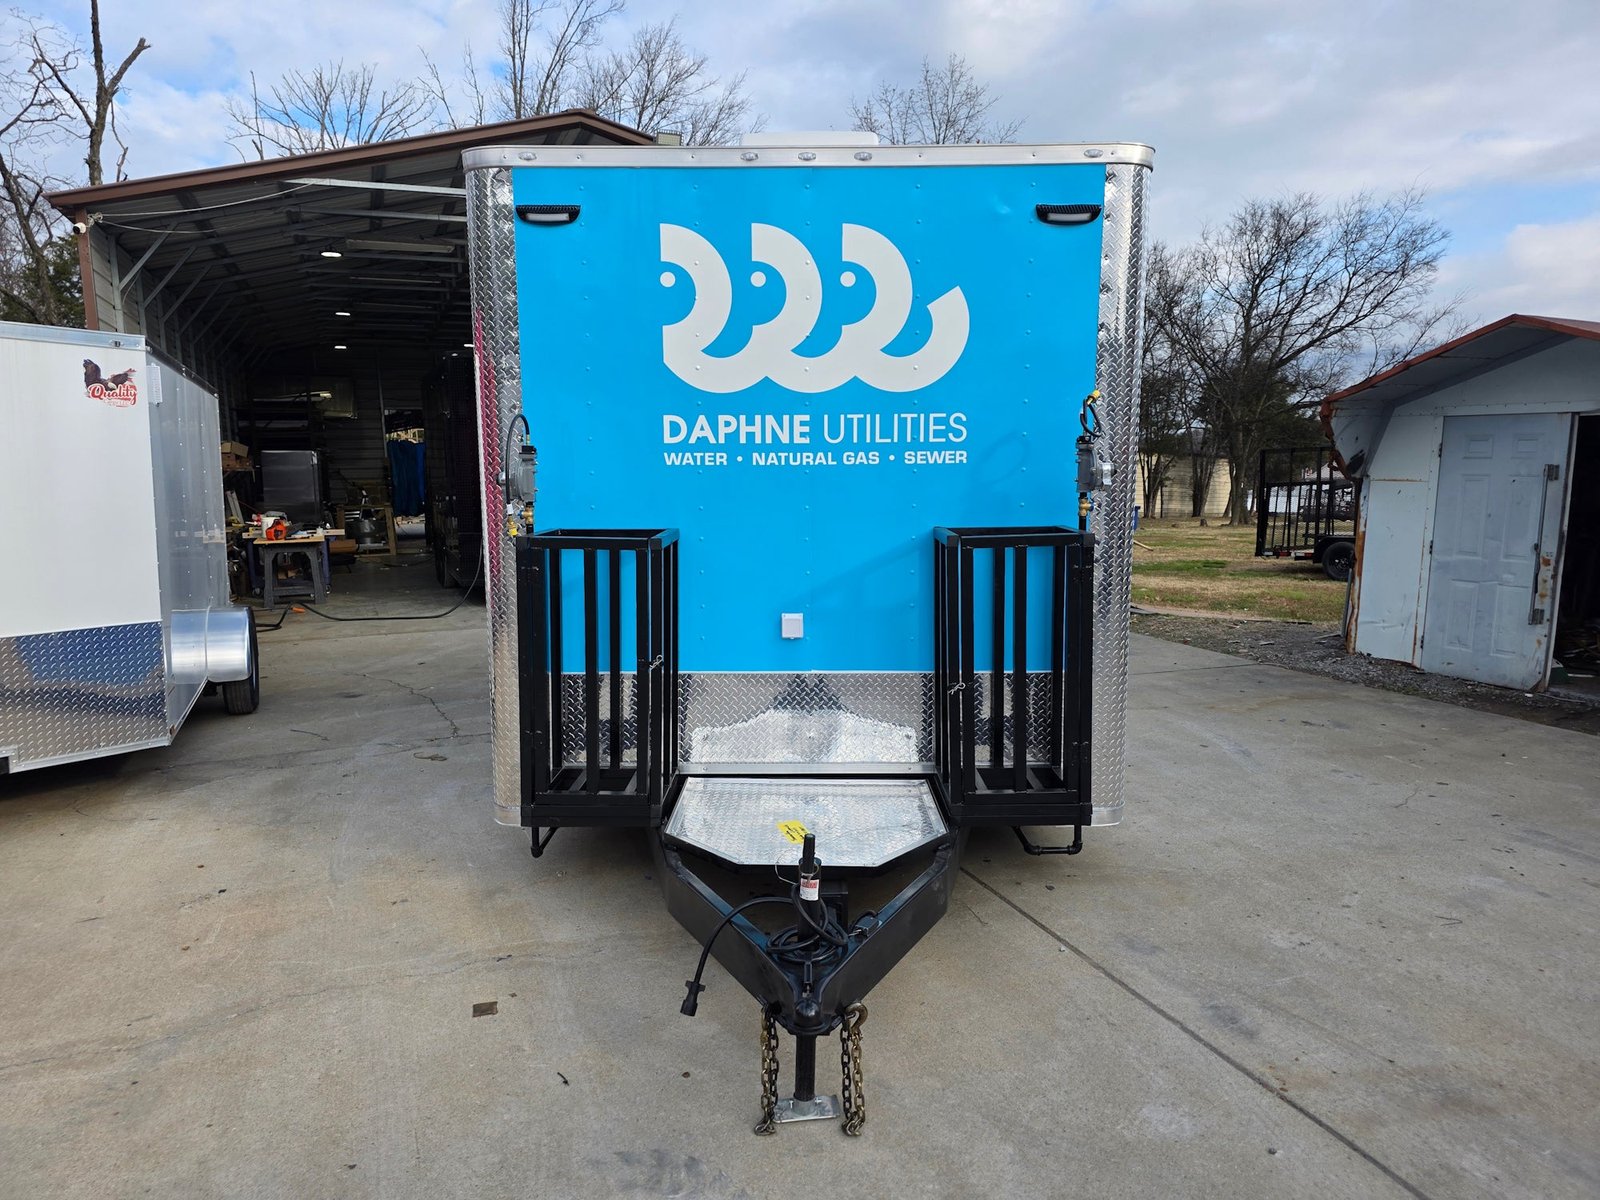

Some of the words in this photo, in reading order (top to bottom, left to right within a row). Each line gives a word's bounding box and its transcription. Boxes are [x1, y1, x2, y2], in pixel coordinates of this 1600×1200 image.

[88, 384, 137, 406] Quality
[662, 414, 811, 444] DAPHNE
[823, 412, 968, 444] UTILITIES
[663, 452, 728, 466] WATER
[752, 451, 837, 466] NATURAL
[842, 451, 880, 465] GAS
[904, 450, 968, 465] SEWER
